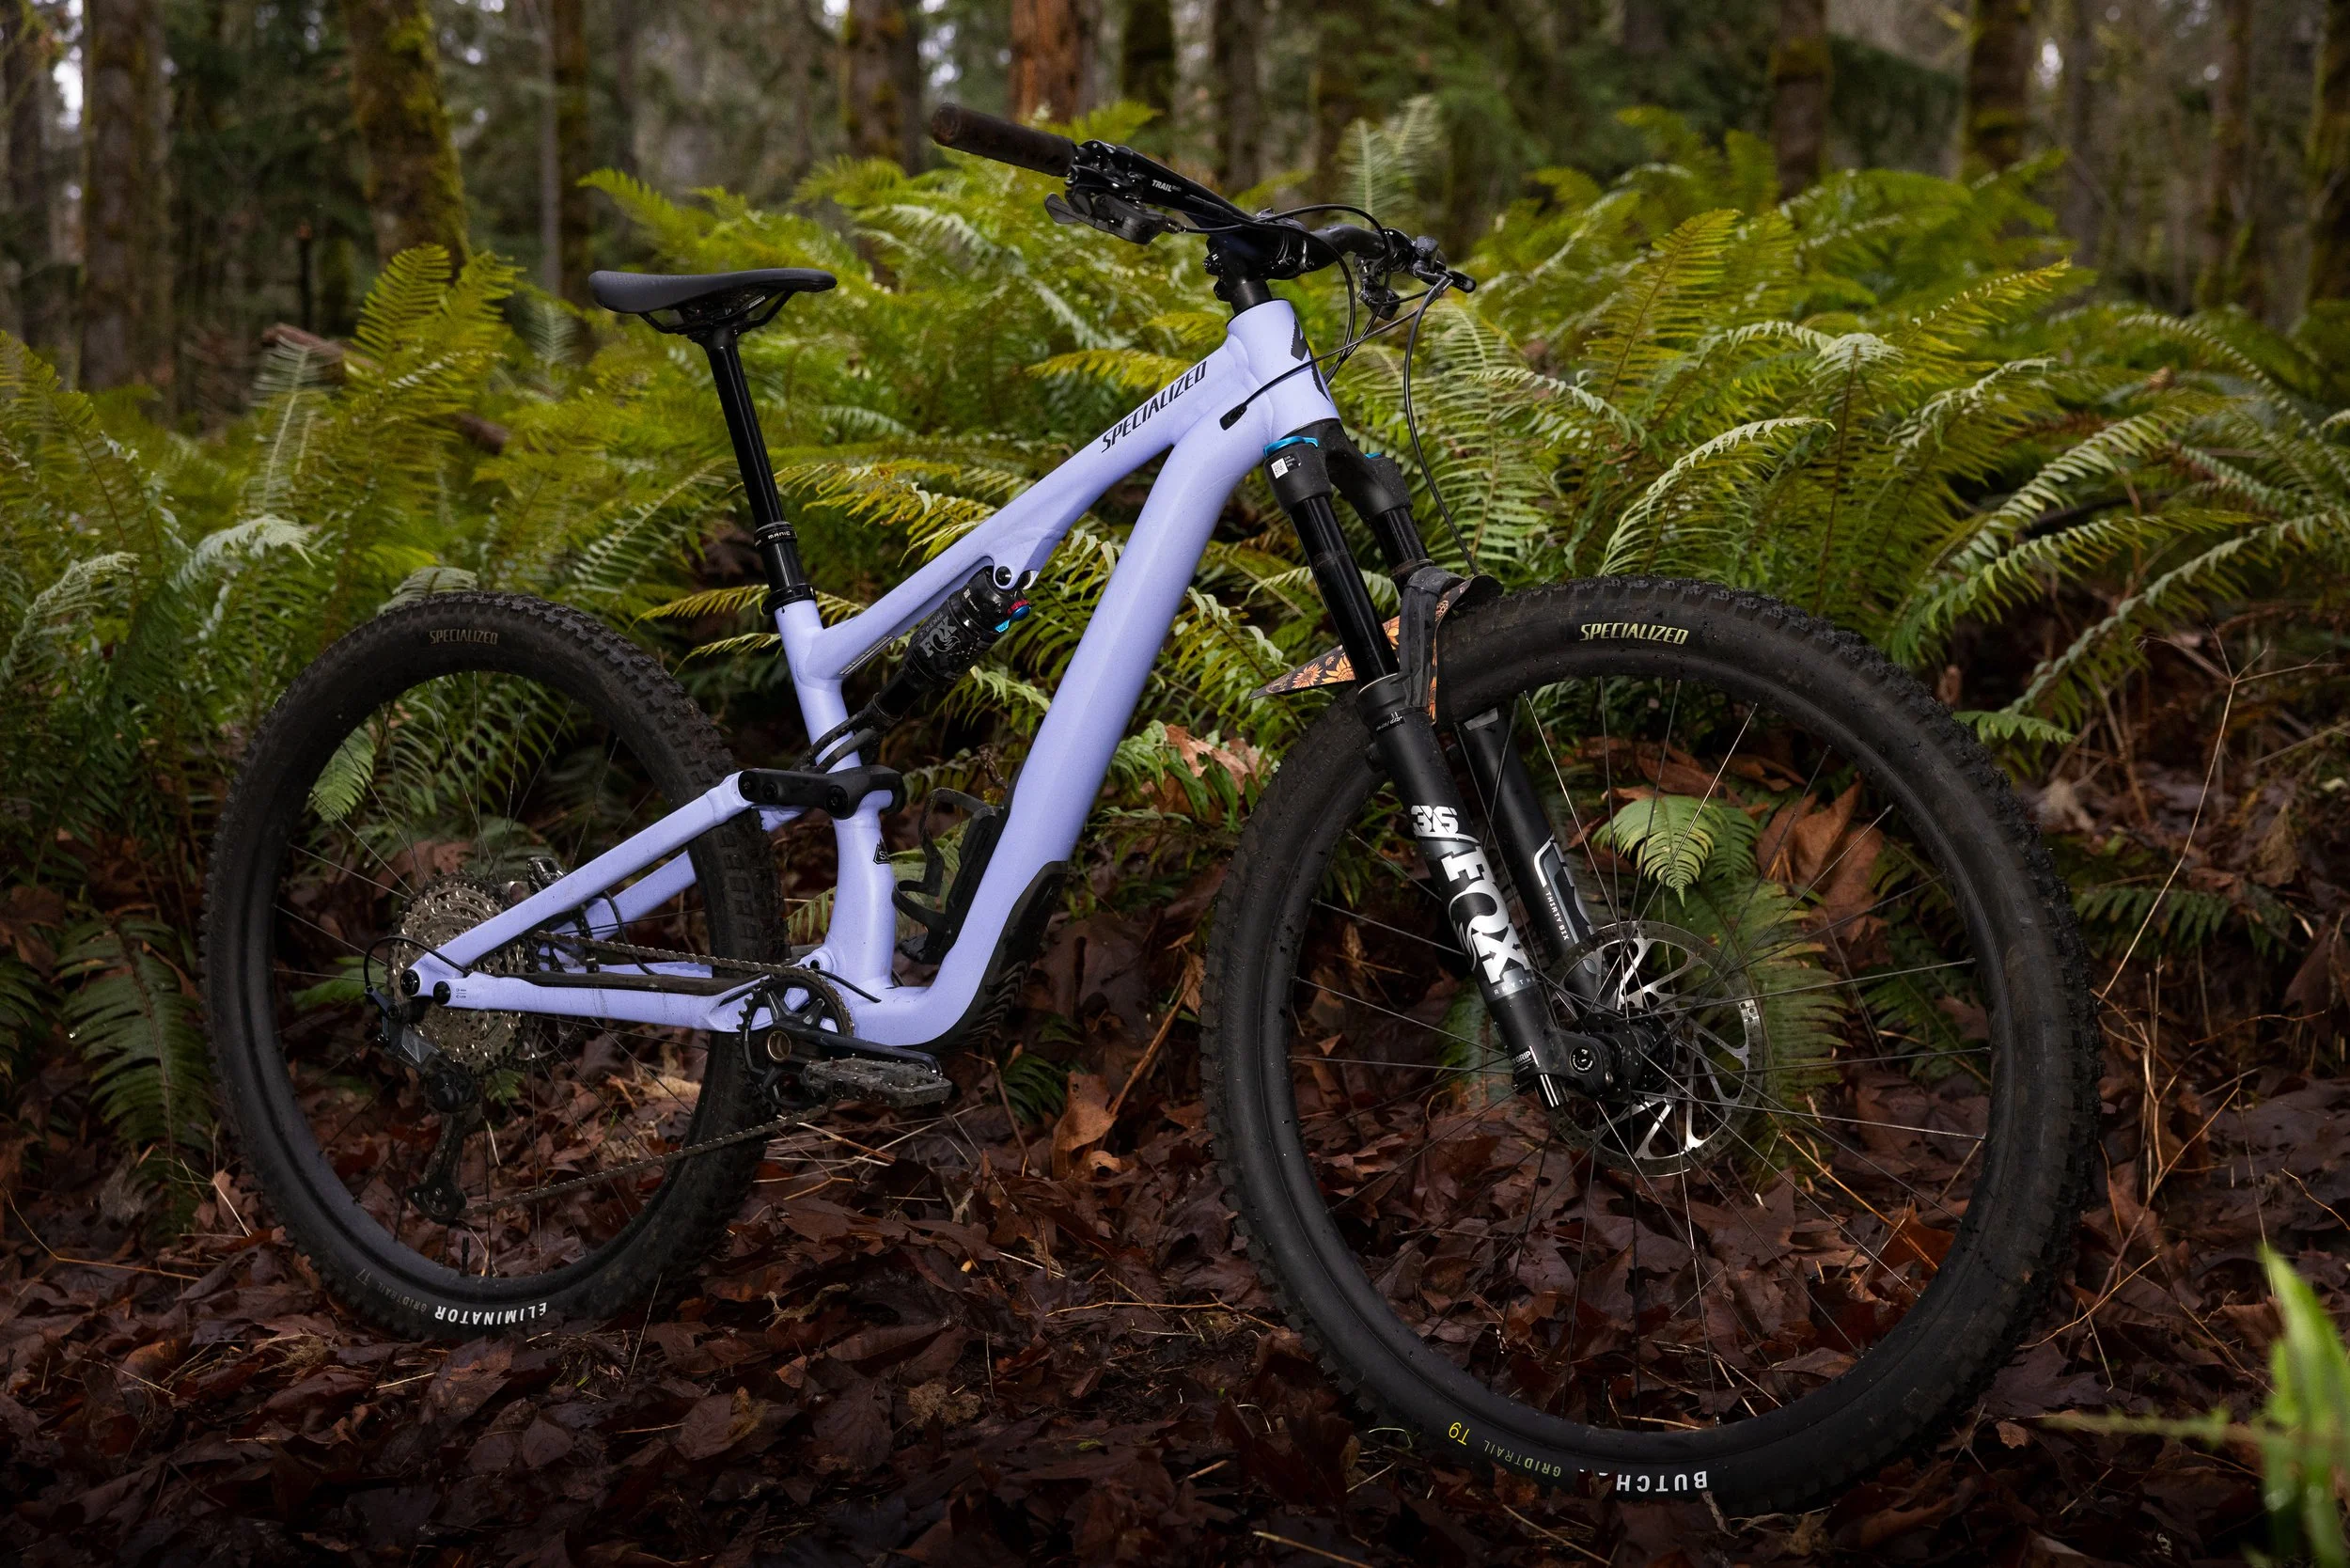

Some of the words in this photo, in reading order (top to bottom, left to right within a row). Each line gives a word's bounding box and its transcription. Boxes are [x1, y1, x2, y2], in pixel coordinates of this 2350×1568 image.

[1152, 179, 1172, 193] TRAIL
[1101, 360, 1207, 453] SPECIALIZED
[429, 629, 498, 645] SPECIALIZED
[920, 616, 961, 658] FOX
[1579, 622, 1689, 645] SPECIALIZED
[1410, 805, 1459, 836] 36
[1441, 846, 1533, 984] FOX
[1545, 890, 1562, 923] THIRTY
[1559, 924, 1570, 941] SIX
[1494, 978, 1531, 996] RHYTH
[355, 1268, 371, 1287] T7
[378, 1281, 428, 1312] GRIDTRAIL
[434, 1302, 547, 1325] ELIMINATOR
[1449, 1421, 1470, 1446] T9
[1484, 1439, 1561, 1478] GRIDTRAIL
[1579, 1468, 1707, 1492] BUTCH
